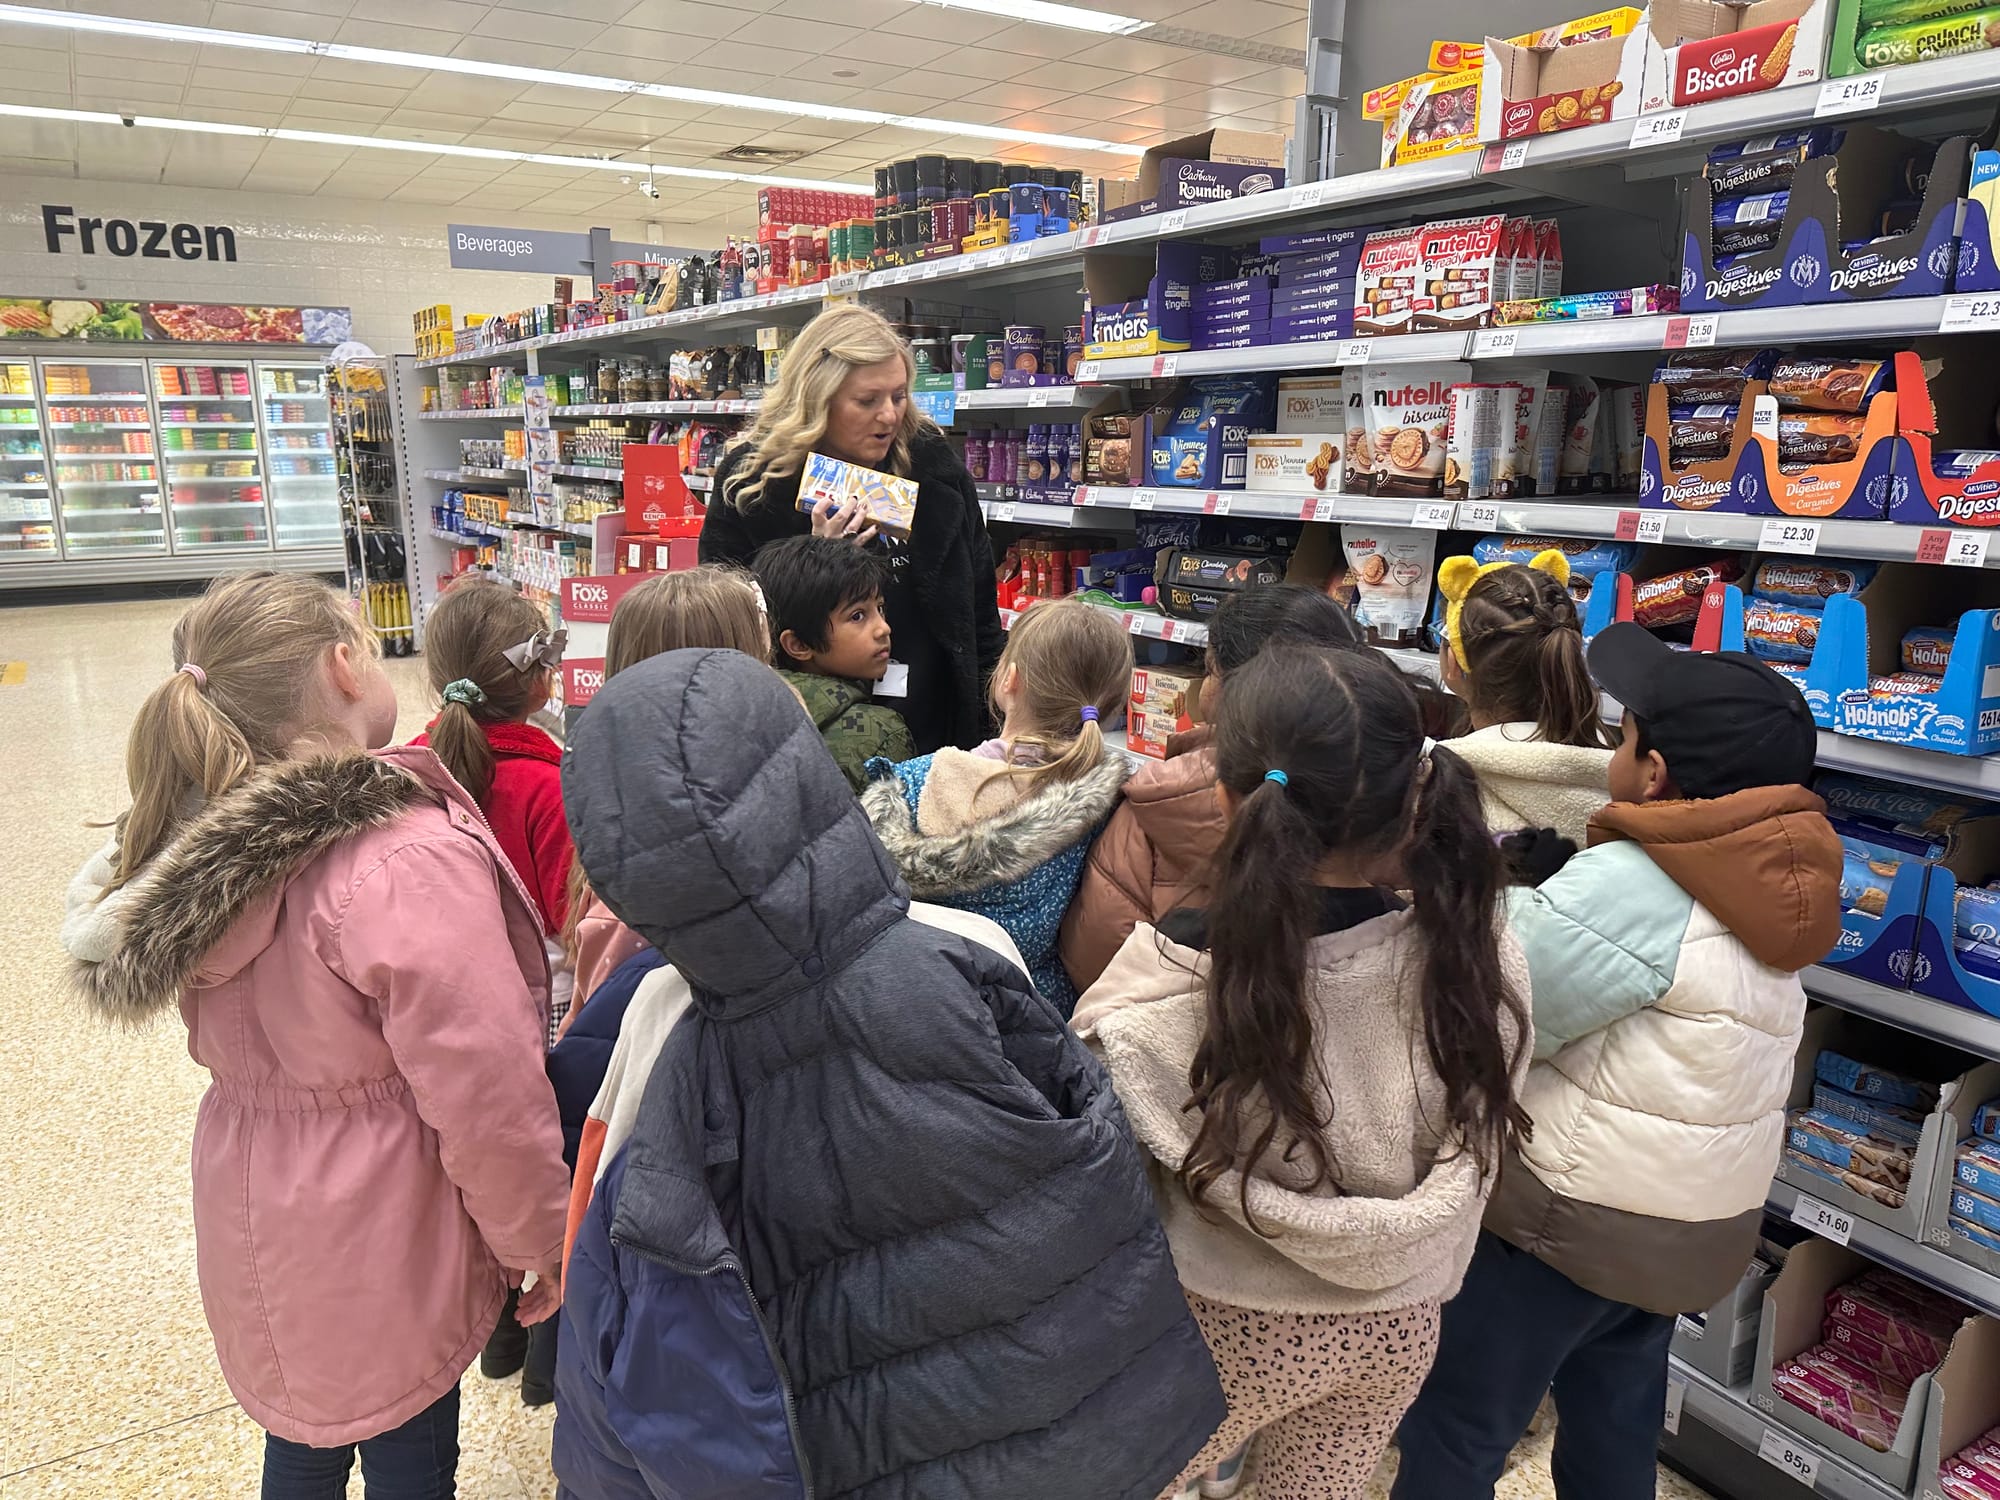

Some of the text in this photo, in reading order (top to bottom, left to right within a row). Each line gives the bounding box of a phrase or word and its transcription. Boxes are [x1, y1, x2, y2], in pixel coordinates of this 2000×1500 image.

[1917, 22, 1982, 54] CRUNCH
[1685, 54, 1759, 95] Biscoff
[1843, 79, 1879, 99] £1.25
[1652, 117, 1681, 133] £1.85
[1504, 148, 1524, 160] £1.25
[1178, 164, 1218, 185] Cadbury
[1711, 164, 1771, 193] Digestives
[1977, 163, 1999, 176] NEW
[1179, 182, 1233, 200] Roundie
[42, 204, 238, 262] Frozen
[1428, 231, 1490, 255] nutella
[457, 232, 534, 256] Beverages
[1367, 242, 1418, 265] nutella
[1705, 267, 1782, 301] Digestives
[1830, 256, 1919, 292] Digestives
[1970, 302, 2000, 316] £2.3
[1093, 317, 1149, 344] fingers
[1491, 334, 1514, 346] £3.25
[1688, 324, 1712, 338] £1.50
[1775, 364, 1834, 381] Digestives
[1402, 405, 1452, 426] biscuit
[1448, 393, 1458, 445] nutella
[1662, 480, 1732, 503] Digestives
[1785, 480, 1842, 497] Digestives
[1967, 483, 1999, 493] McVitie's
[1796, 495, 1836, 510] Caramel
[1938, 495, 2000, 520] Digest
[1473, 507, 1495, 521] £3.25
[1639, 521, 1661, 533] £1.50
[1783, 526, 1815, 541] £2.30
[1347, 538, 1377, 549] nutella
[1961, 543, 1980, 556] £2
[1765, 566, 1823, 586] Hobnobs
[1637, 573, 1685, 603] Hobnobs
[573, 602, 609, 611] CLASSIC
[1746, 616, 1801, 634] Hobnobs
[1912, 647, 1950, 665] Hobn
[1133, 674, 1146, 694] LU
[1843, 703, 1919, 728] Hobnobs
[1930, 733, 1967, 746] Chocolate
[1828, 787, 1929, 813] Rich Tea
[1836, 928, 1865, 948] Tea
[1818, 1210, 1849, 1233] £1.60
[1783, 1449, 1811, 1474] 85p
